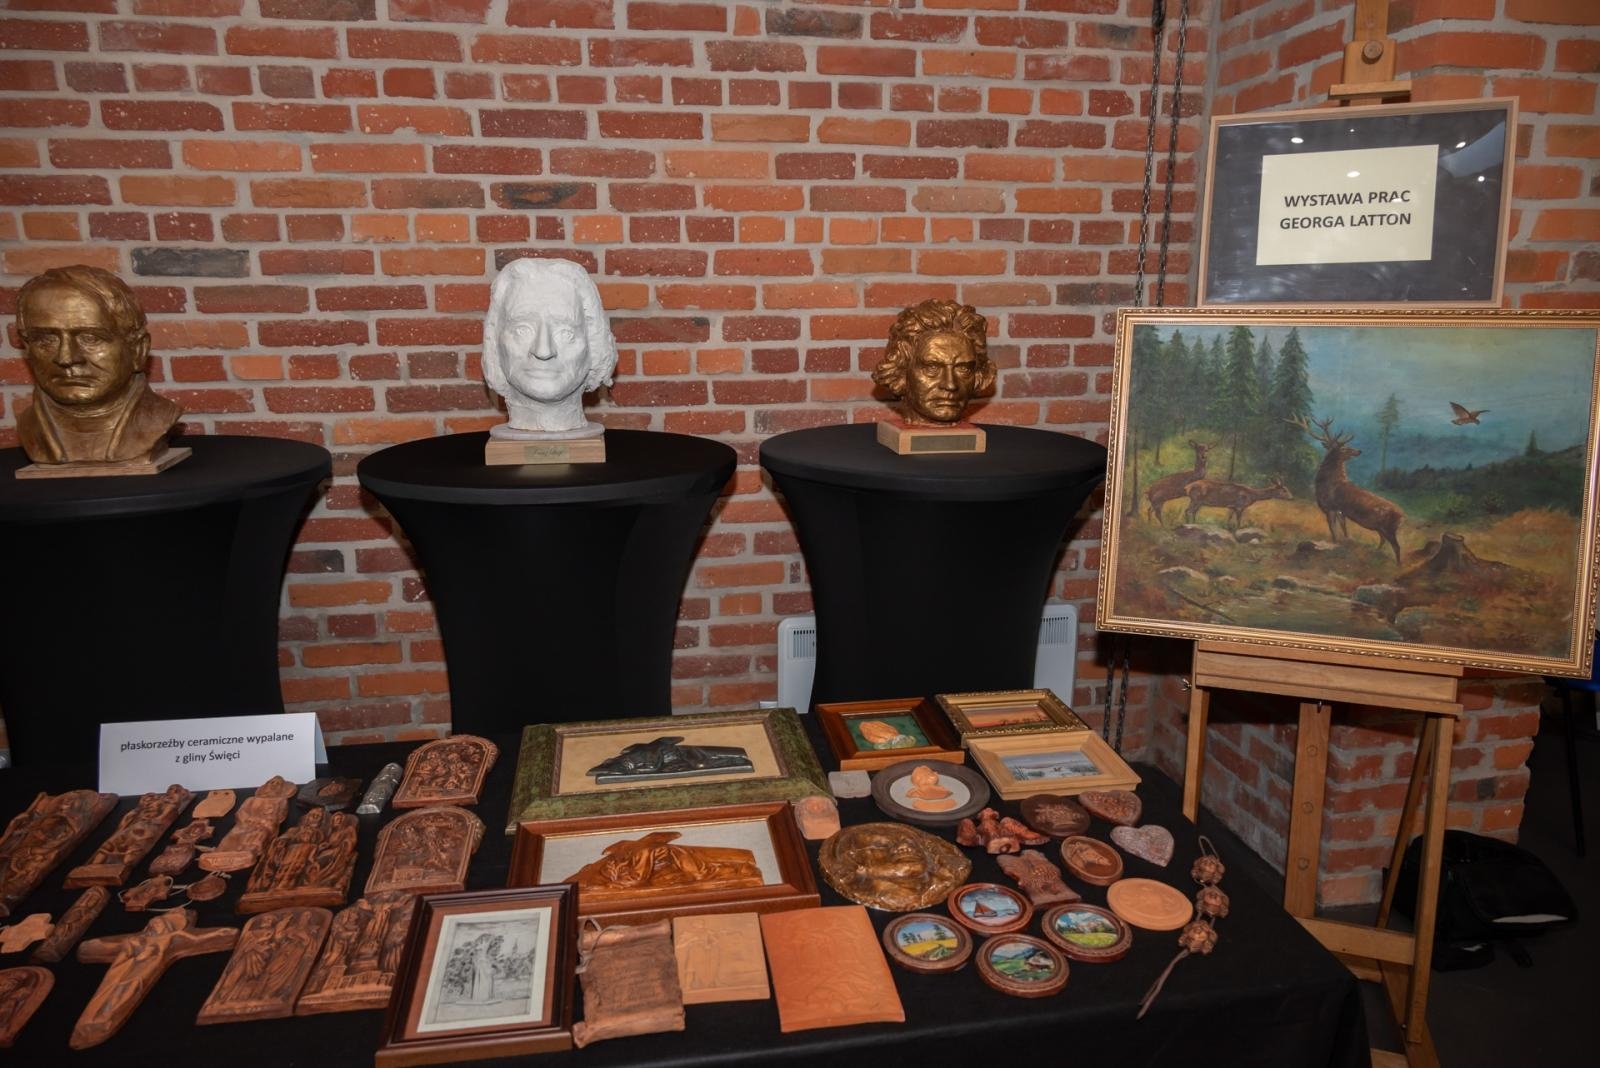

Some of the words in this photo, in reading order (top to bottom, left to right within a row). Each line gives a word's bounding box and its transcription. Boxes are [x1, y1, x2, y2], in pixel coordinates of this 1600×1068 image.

[1284, 192, 1363, 208] WYSTAWA
[1368, 190, 1411, 204] PRAC
[1280, 215, 1345, 230] GEORGA
[1350, 213, 1411, 227] LATTON
[120, 739, 185, 752] płaskorzeźby
[187, 735, 244, 747] ceramiczne
[247, 732, 294, 744] wypalane
[175, 755, 180, 763] z
[182, 752, 206, 764] gliny
[209, 750, 240, 762] Święci
